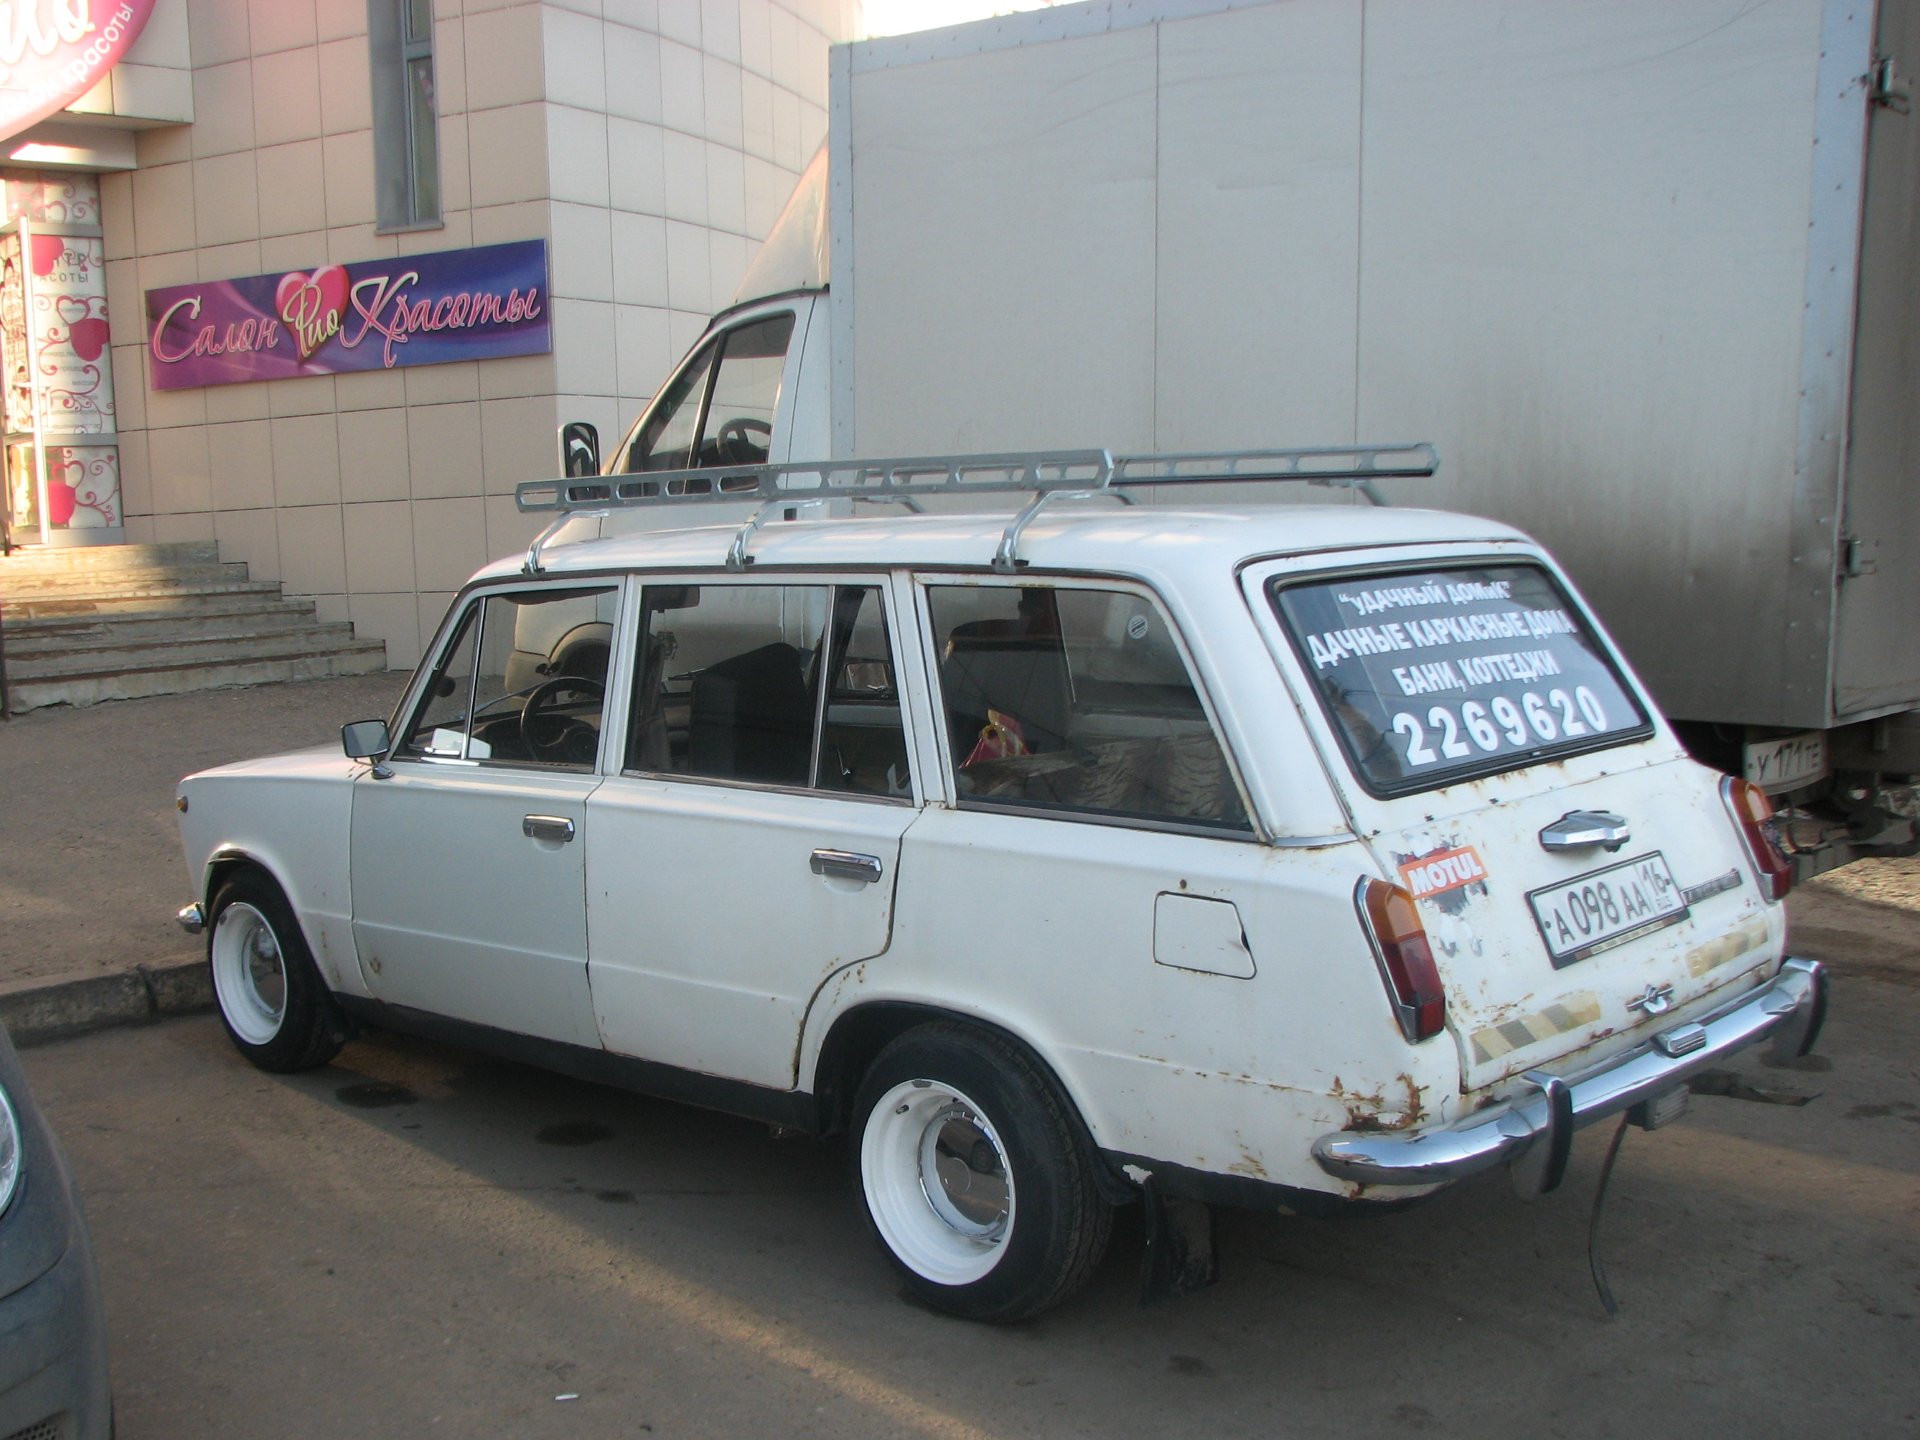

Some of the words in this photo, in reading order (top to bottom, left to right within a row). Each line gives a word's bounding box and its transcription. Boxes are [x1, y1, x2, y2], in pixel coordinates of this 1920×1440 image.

[153, 295, 279, 363] Салон
[339, 271, 540, 369] Красоты
[1307, 622, 1413, 669] ДАЧНЫЕ
[1404, 611, 1530, 648] КАРКАСНЫЕ
[1523, 608, 1577, 640] ДОМА
[1392, 661, 1467, 697] БАНИ,
[1457, 650, 1561, 686] КОТТЕДЖИ
[1393, 686, 1607, 767] 2269620
[1407, 852, 1483, 896] MOTUL
